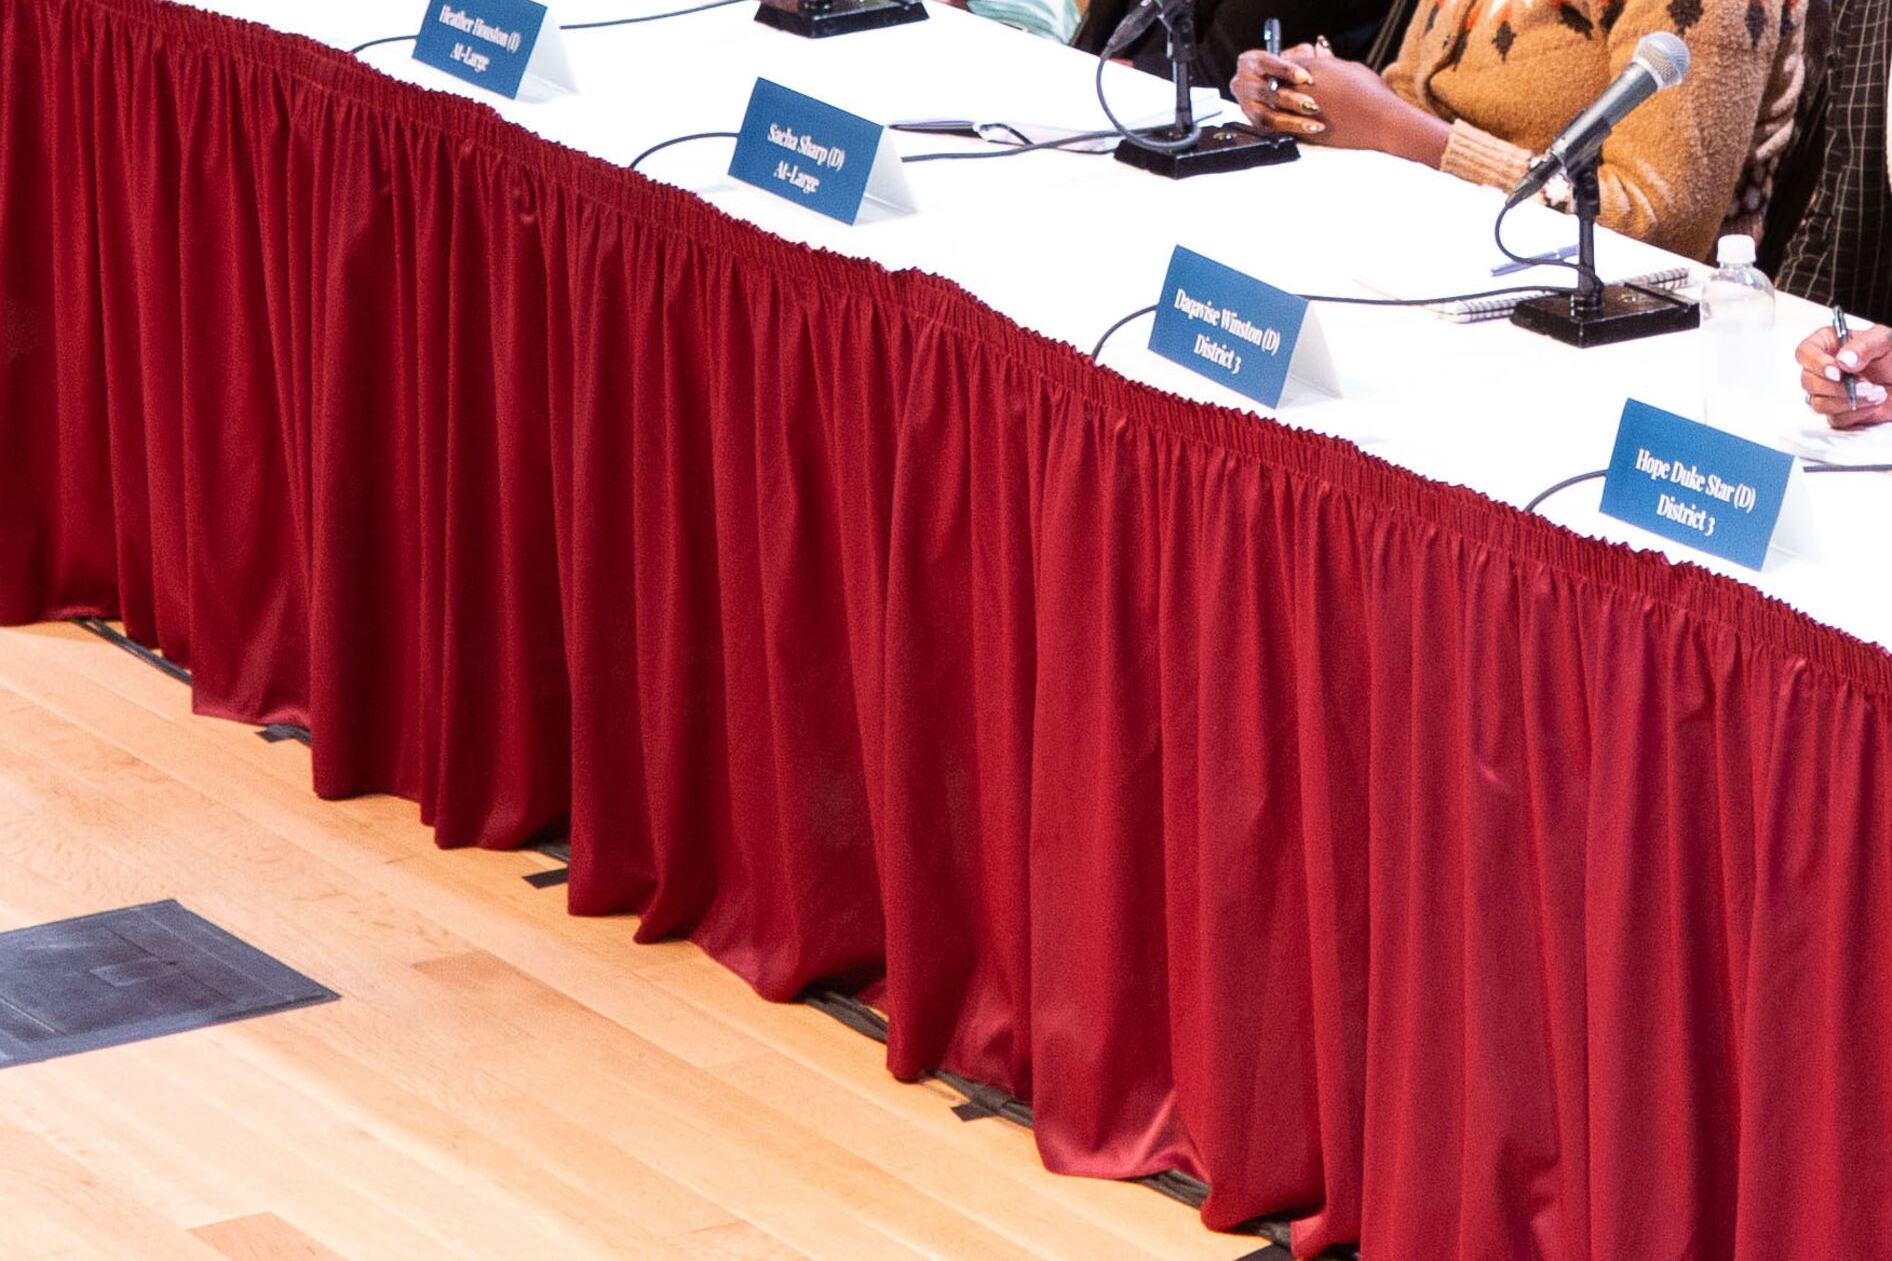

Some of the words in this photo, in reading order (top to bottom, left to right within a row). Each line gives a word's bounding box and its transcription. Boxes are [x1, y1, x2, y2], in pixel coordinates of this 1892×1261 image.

[438, 4, 475, 34] Heather
[472, 17, 510, 49] Houston
[449, 42, 491, 74] At-Large
[766, 122, 798, 152] Sacha
[798, 134, 829, 167] Sharp
[826, 146, 846, 172] (D)
[773, 160, 821, 194] At-Large
[1193, 333, 1236, 370] District
[1231, 355, 1242, 375] 3
[1220, 308, 1265, 345] Winston
[1261, 327, 1281, 357] (D)
[1635, 448, 1671, 482] Hope
[1670, 460, 1707, 492] Duke
[1704, 473, 1736, 504] Star
[1733, 483, 1757, 514] (D)
[1655, 494, 1708, 531] District
[1704, 516, 1716, 537] 3
